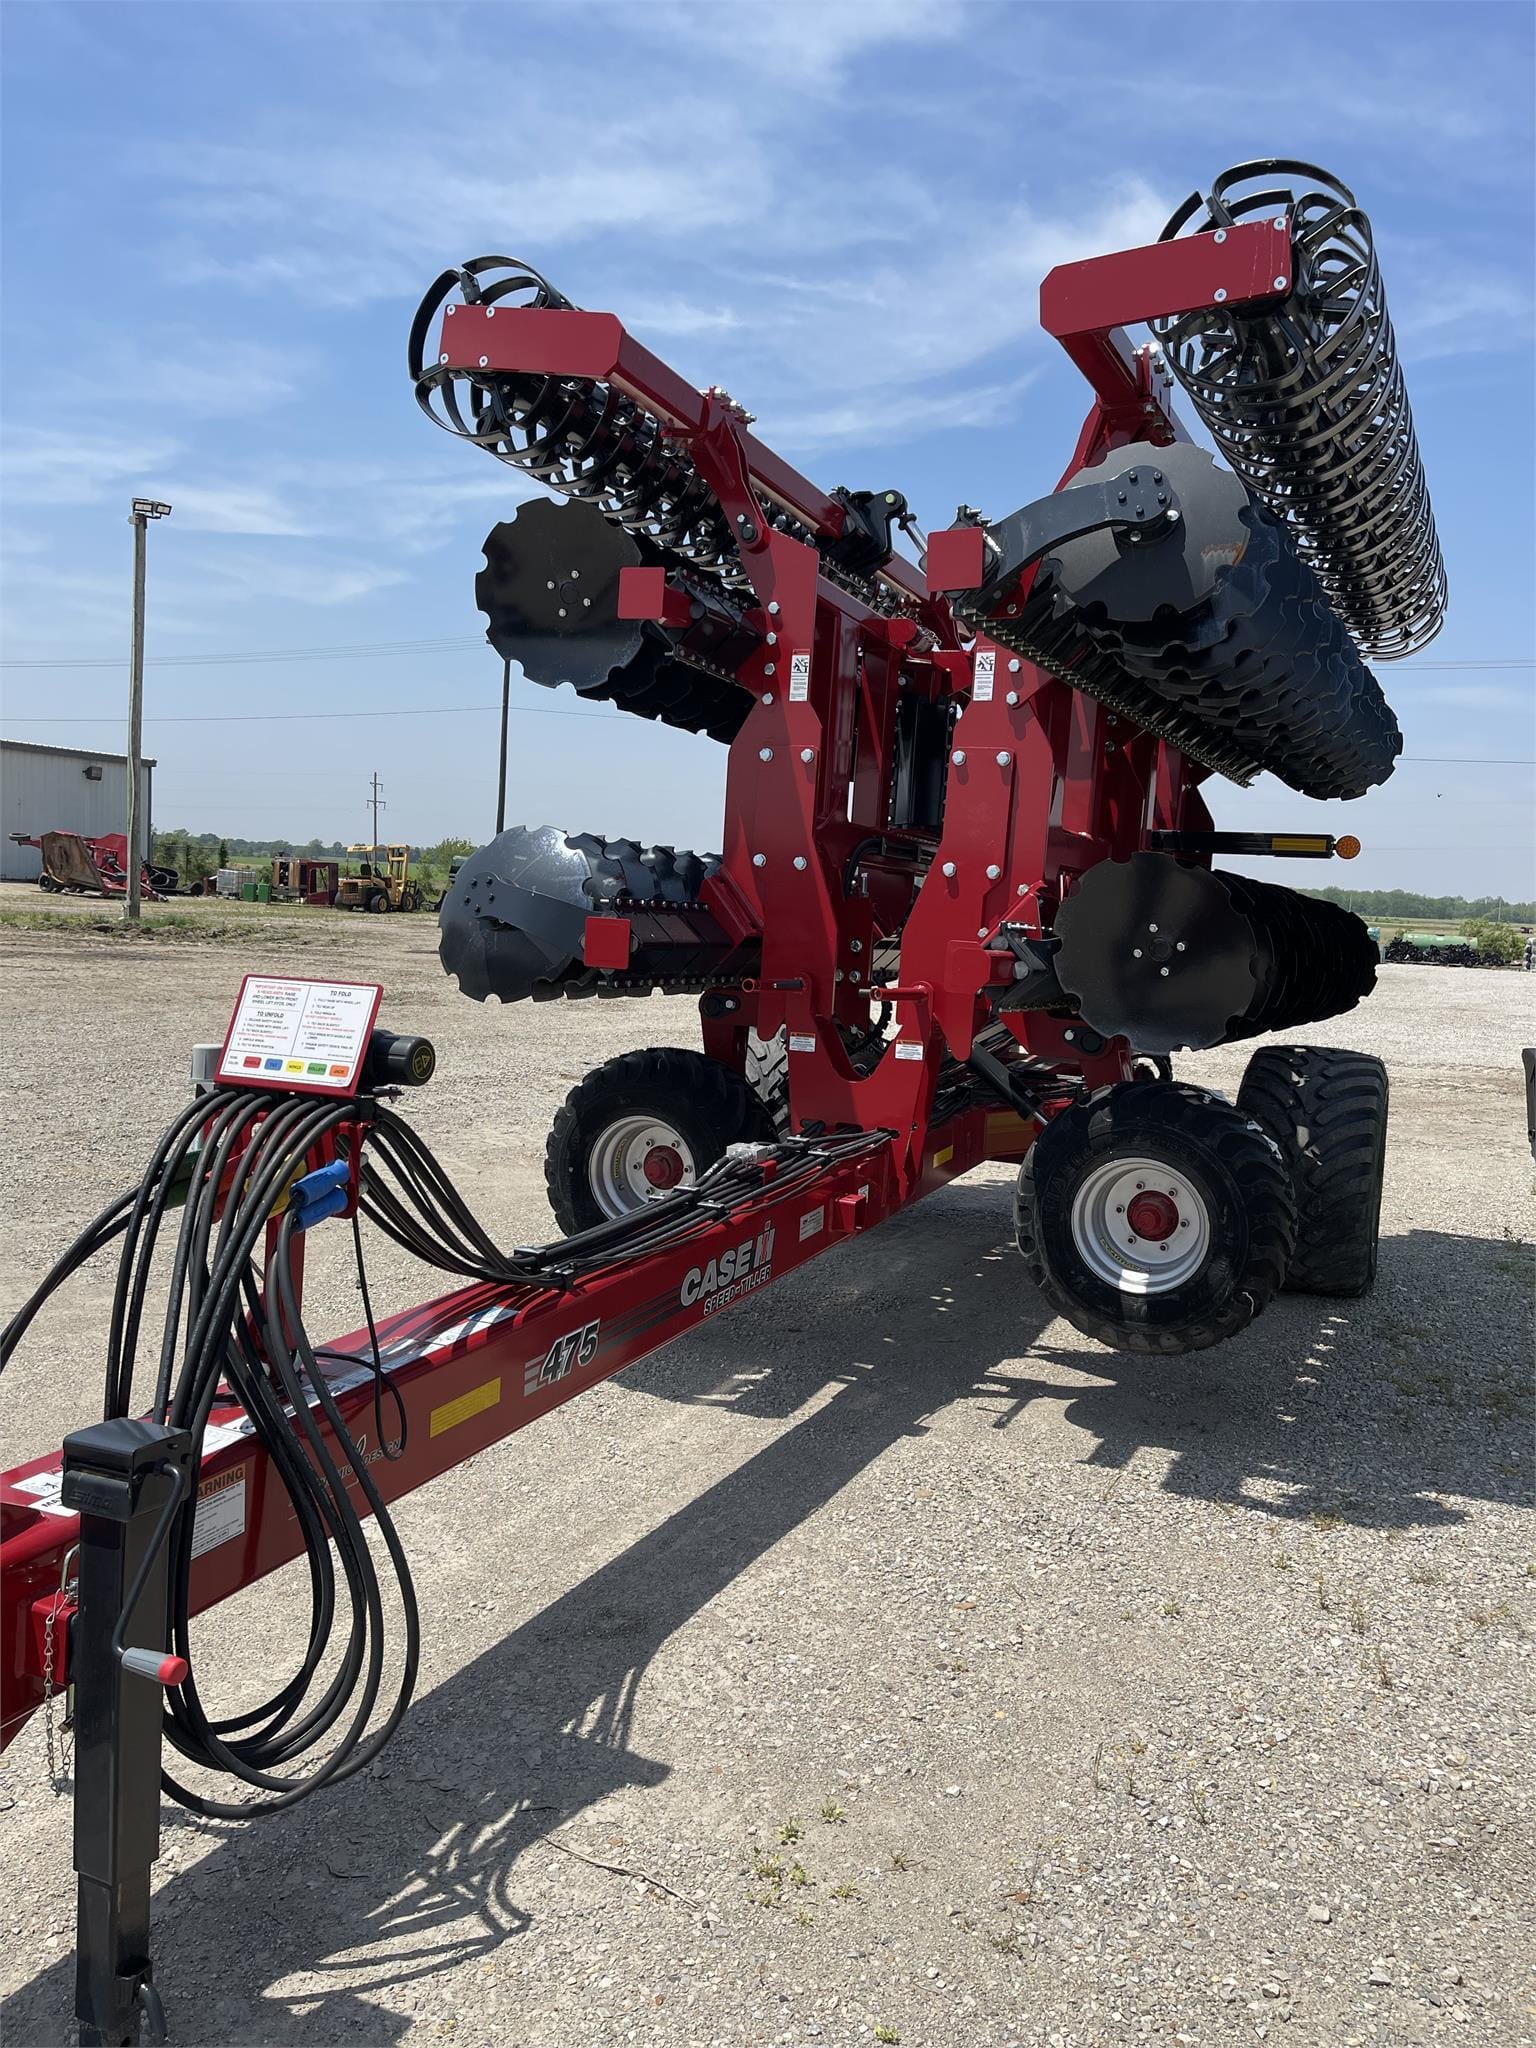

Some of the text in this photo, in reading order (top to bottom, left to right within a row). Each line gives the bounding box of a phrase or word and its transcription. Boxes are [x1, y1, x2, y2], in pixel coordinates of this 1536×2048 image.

[680, 1240, 753, 1307] CASE
[703, 1265, 772, 1317] SPEED-TILLER
[540, 1318, 600, 1385] 475
[198, 1467, 244, 1497] ARNING
